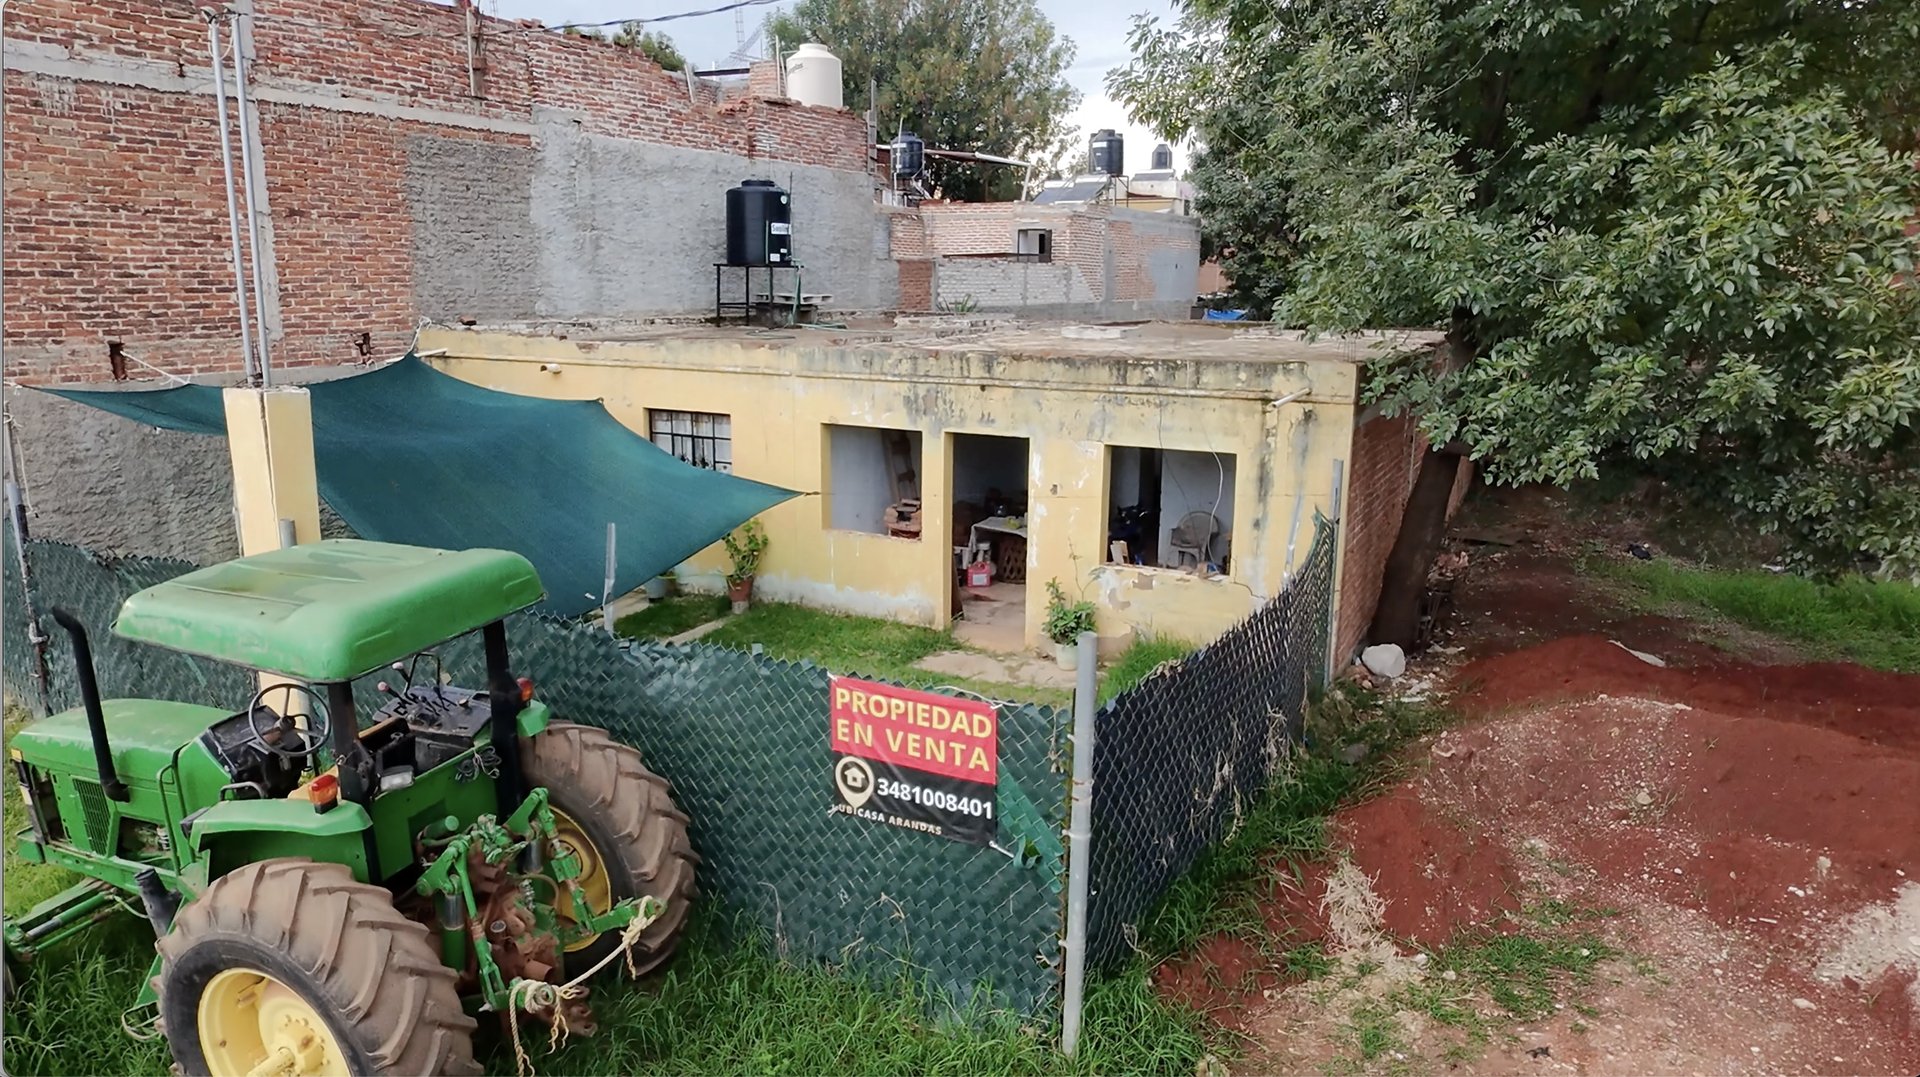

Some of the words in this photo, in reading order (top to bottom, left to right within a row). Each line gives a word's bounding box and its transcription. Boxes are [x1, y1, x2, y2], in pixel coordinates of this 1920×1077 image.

[835, 687, 993, 738] PROPIEDAD
[836, 719, 873, 747] EN
[885, 728, 990, 772] VENTA
[838, 804, 885, 822] UBICASA
[888, 815, 942, 835] ARANDAS
[877, 778, 993, 820] 3481008401
